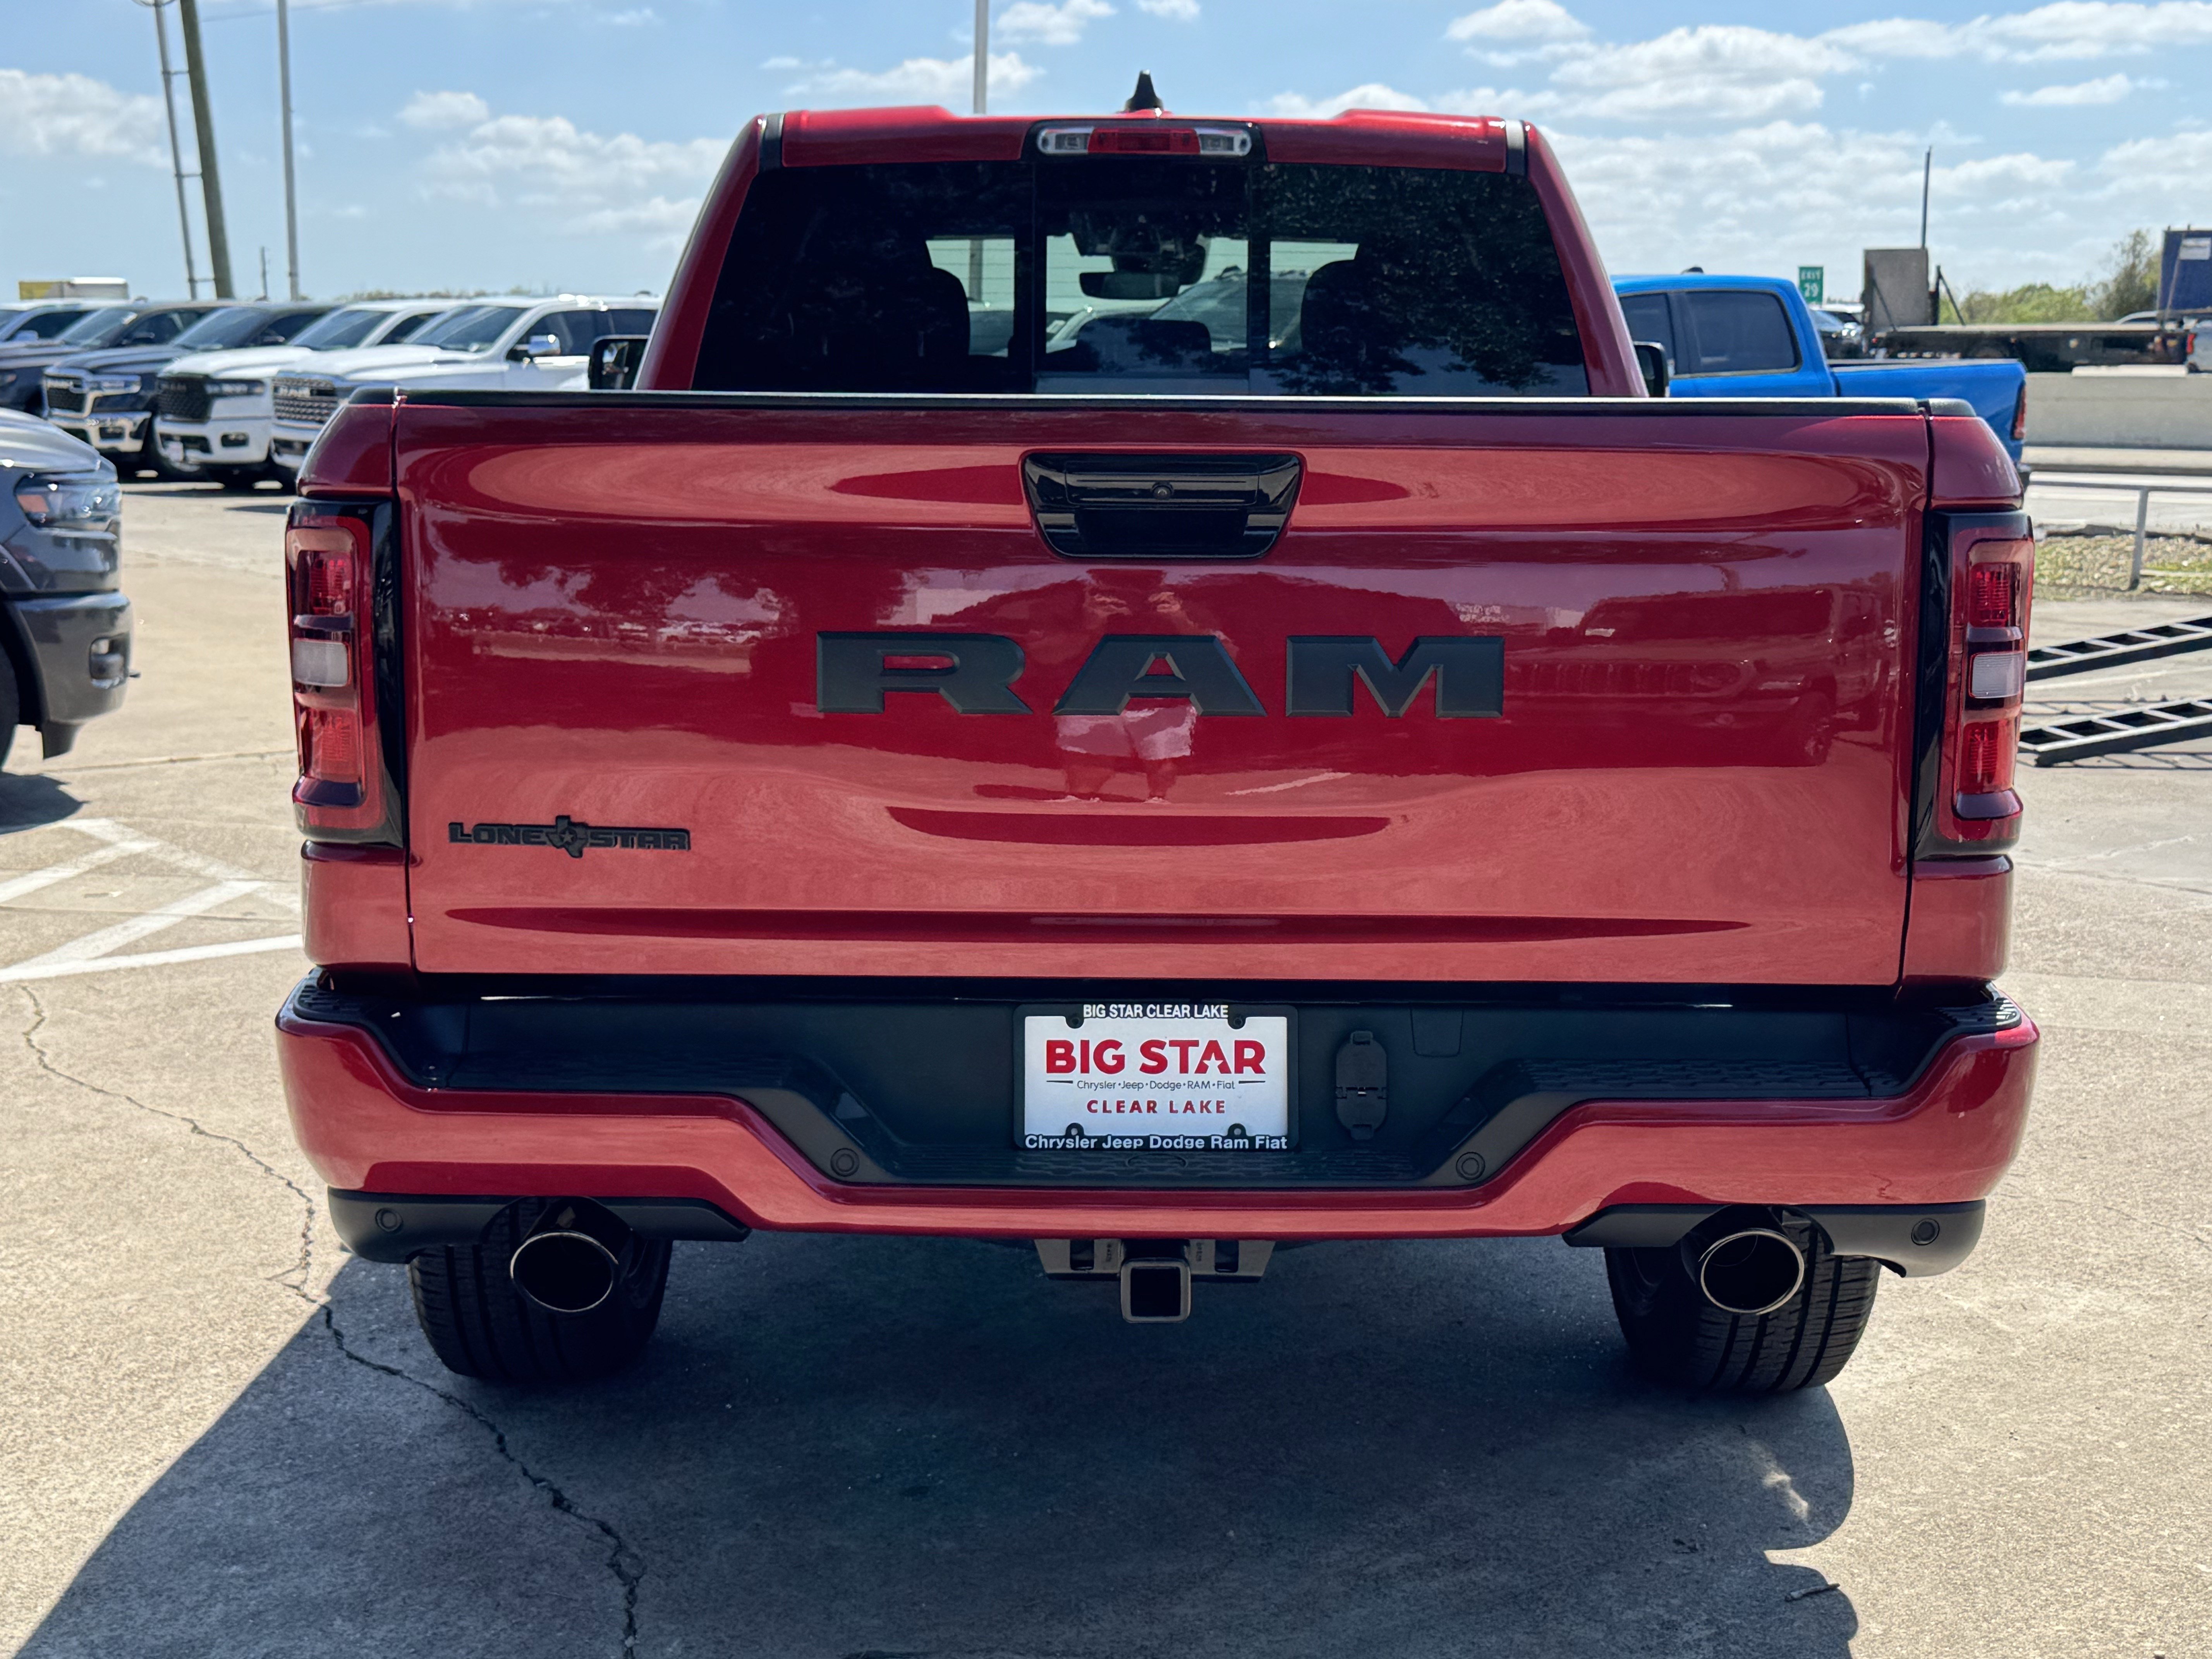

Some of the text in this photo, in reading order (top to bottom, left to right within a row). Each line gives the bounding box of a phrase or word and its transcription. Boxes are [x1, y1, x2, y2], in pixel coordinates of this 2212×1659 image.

[1804, 283, 1819, 297] 29
[816, 630, 1505, 718] RAM
[448, 823, 691, 850] LONE STAR
[1083, 1005, 1228, 1018] BIG STAR CLEAR LAKE
[1046, 1039, 1266, 1074] BIG STAR
[1077, 1080, 1116, 1091] Chrysler
[1149, 1080, 1182, 1091] Dodge
[1187, 1081, 1211, 1089] RAM
[1217, 1081, 1235, 1090] Fiat
[1087, 1100, 1226, 1114] CLEAR LAKE
[1025, 1135, 1287, 1149] Chrysler Jeep Dodge Ram Fiat
